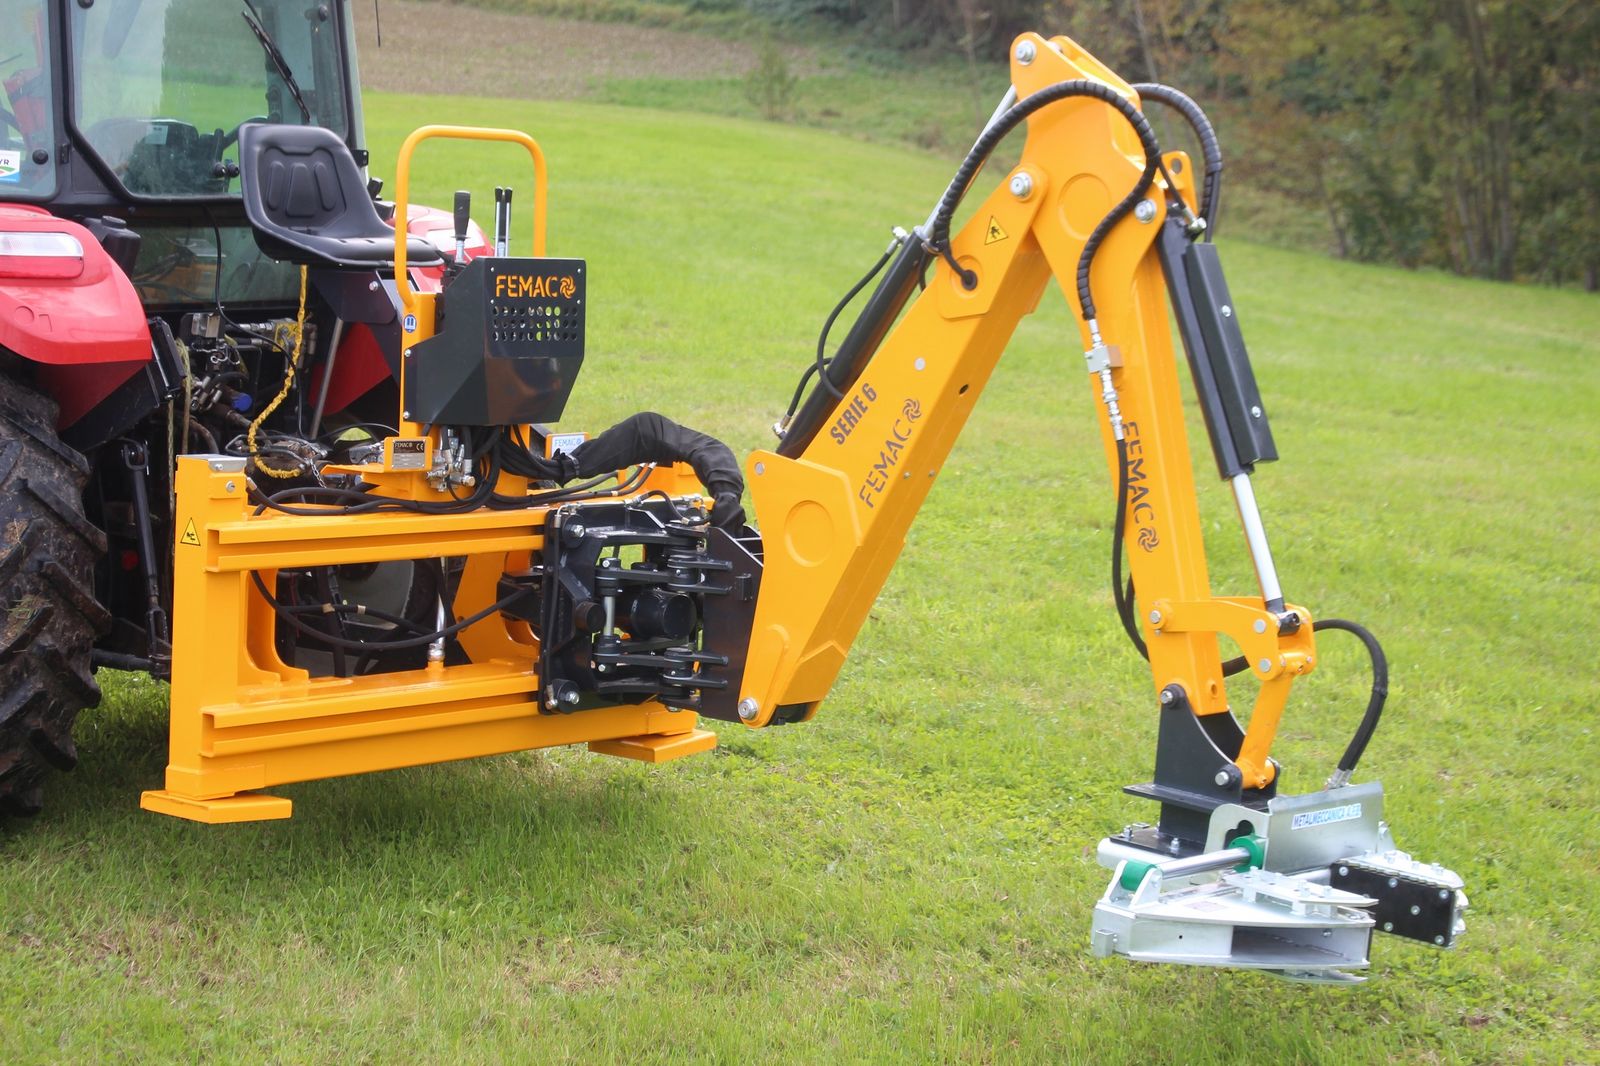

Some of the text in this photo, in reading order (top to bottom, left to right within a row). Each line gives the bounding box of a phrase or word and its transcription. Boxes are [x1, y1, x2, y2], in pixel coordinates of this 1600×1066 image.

[495, 274, 558, 298] FEMAC
[829, 382, 877, 445] SERIE 6
[858, 418, 912, 508] FEMAC
